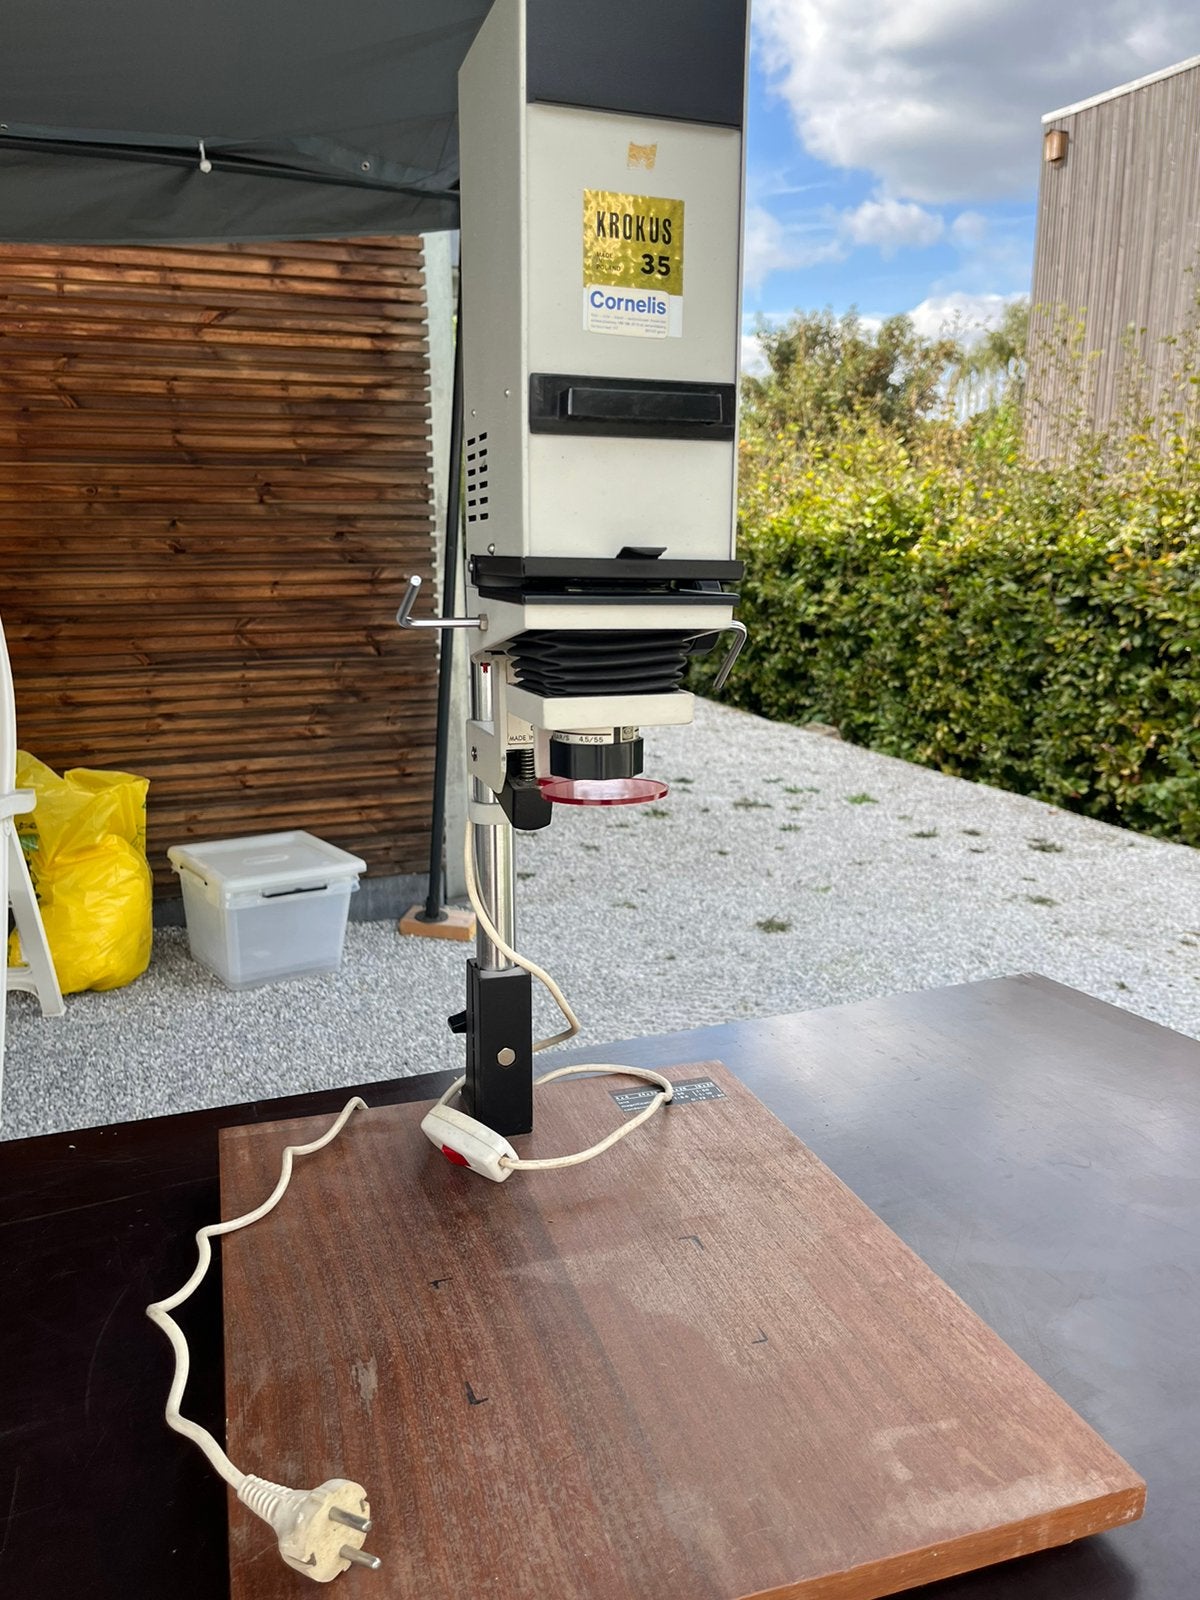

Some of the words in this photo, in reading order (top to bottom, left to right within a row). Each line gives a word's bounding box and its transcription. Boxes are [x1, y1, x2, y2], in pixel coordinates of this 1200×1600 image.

[596, 210, 672, 246] KROKUS
[596, 251, 613, 259] MADE
[640, 253, 671, 277] 35
[590, 290, 667, 315] Cornelis
[509, 734, 527, 742] MADE
